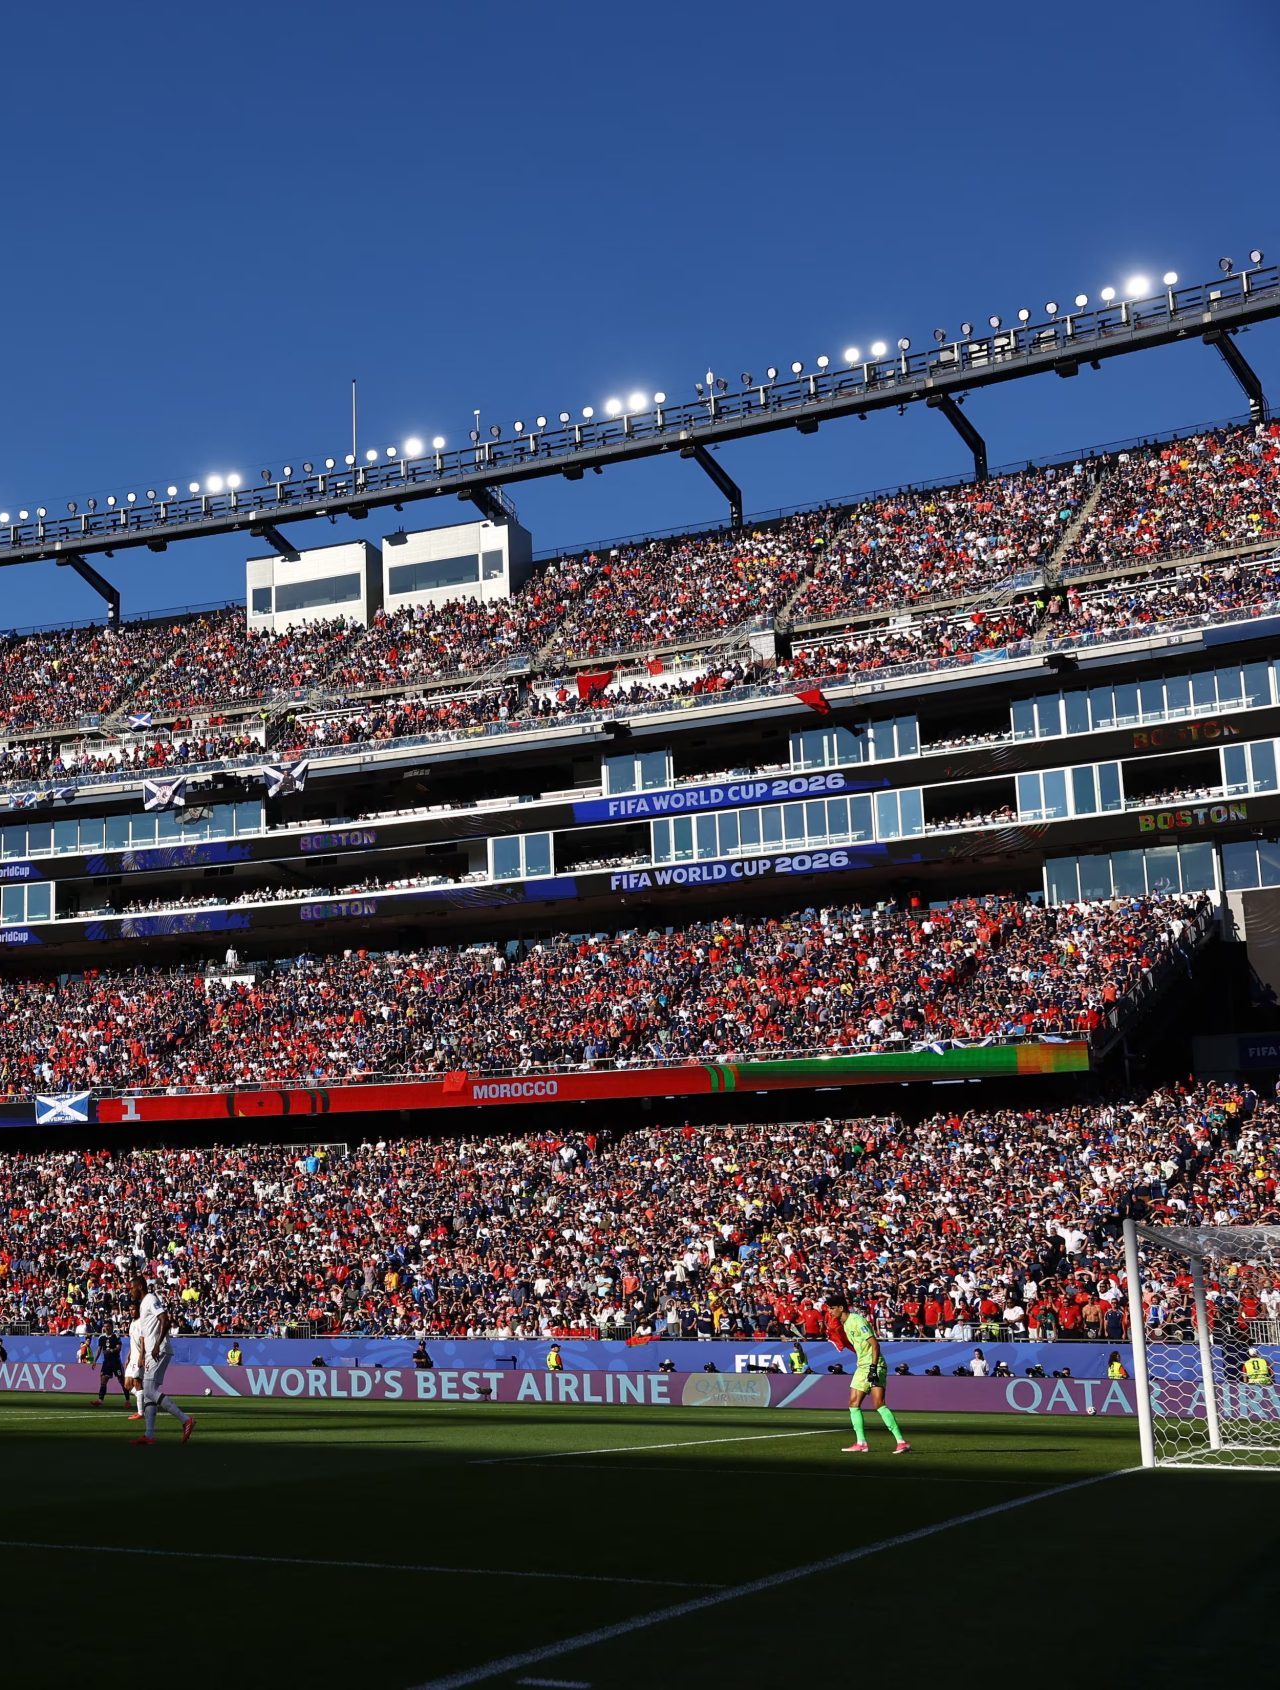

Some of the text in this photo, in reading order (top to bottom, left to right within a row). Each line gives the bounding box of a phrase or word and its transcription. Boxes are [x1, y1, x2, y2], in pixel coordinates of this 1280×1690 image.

[608, 772, 846, 817] FIFA WORLD CUP 2026
[1138, 801, 1248, 832] BOSTON
[300, 830, 377, 851] BOSTON
[610, 850, 849, 890] FIFA WORLD CUP 2026
[300, 900, 377, 920] BOSTON
[1248, 1046, 1277, 1057] FIFA
[473, 1080, 558, 1099] MOROCCO
[122, 1099, 141, 1120] 1
[734, 1354, 788, 1374] FIFA
[416, 1371, 504, 1400] BEST
[517, 1372, 670, 1404] AIRLINE
